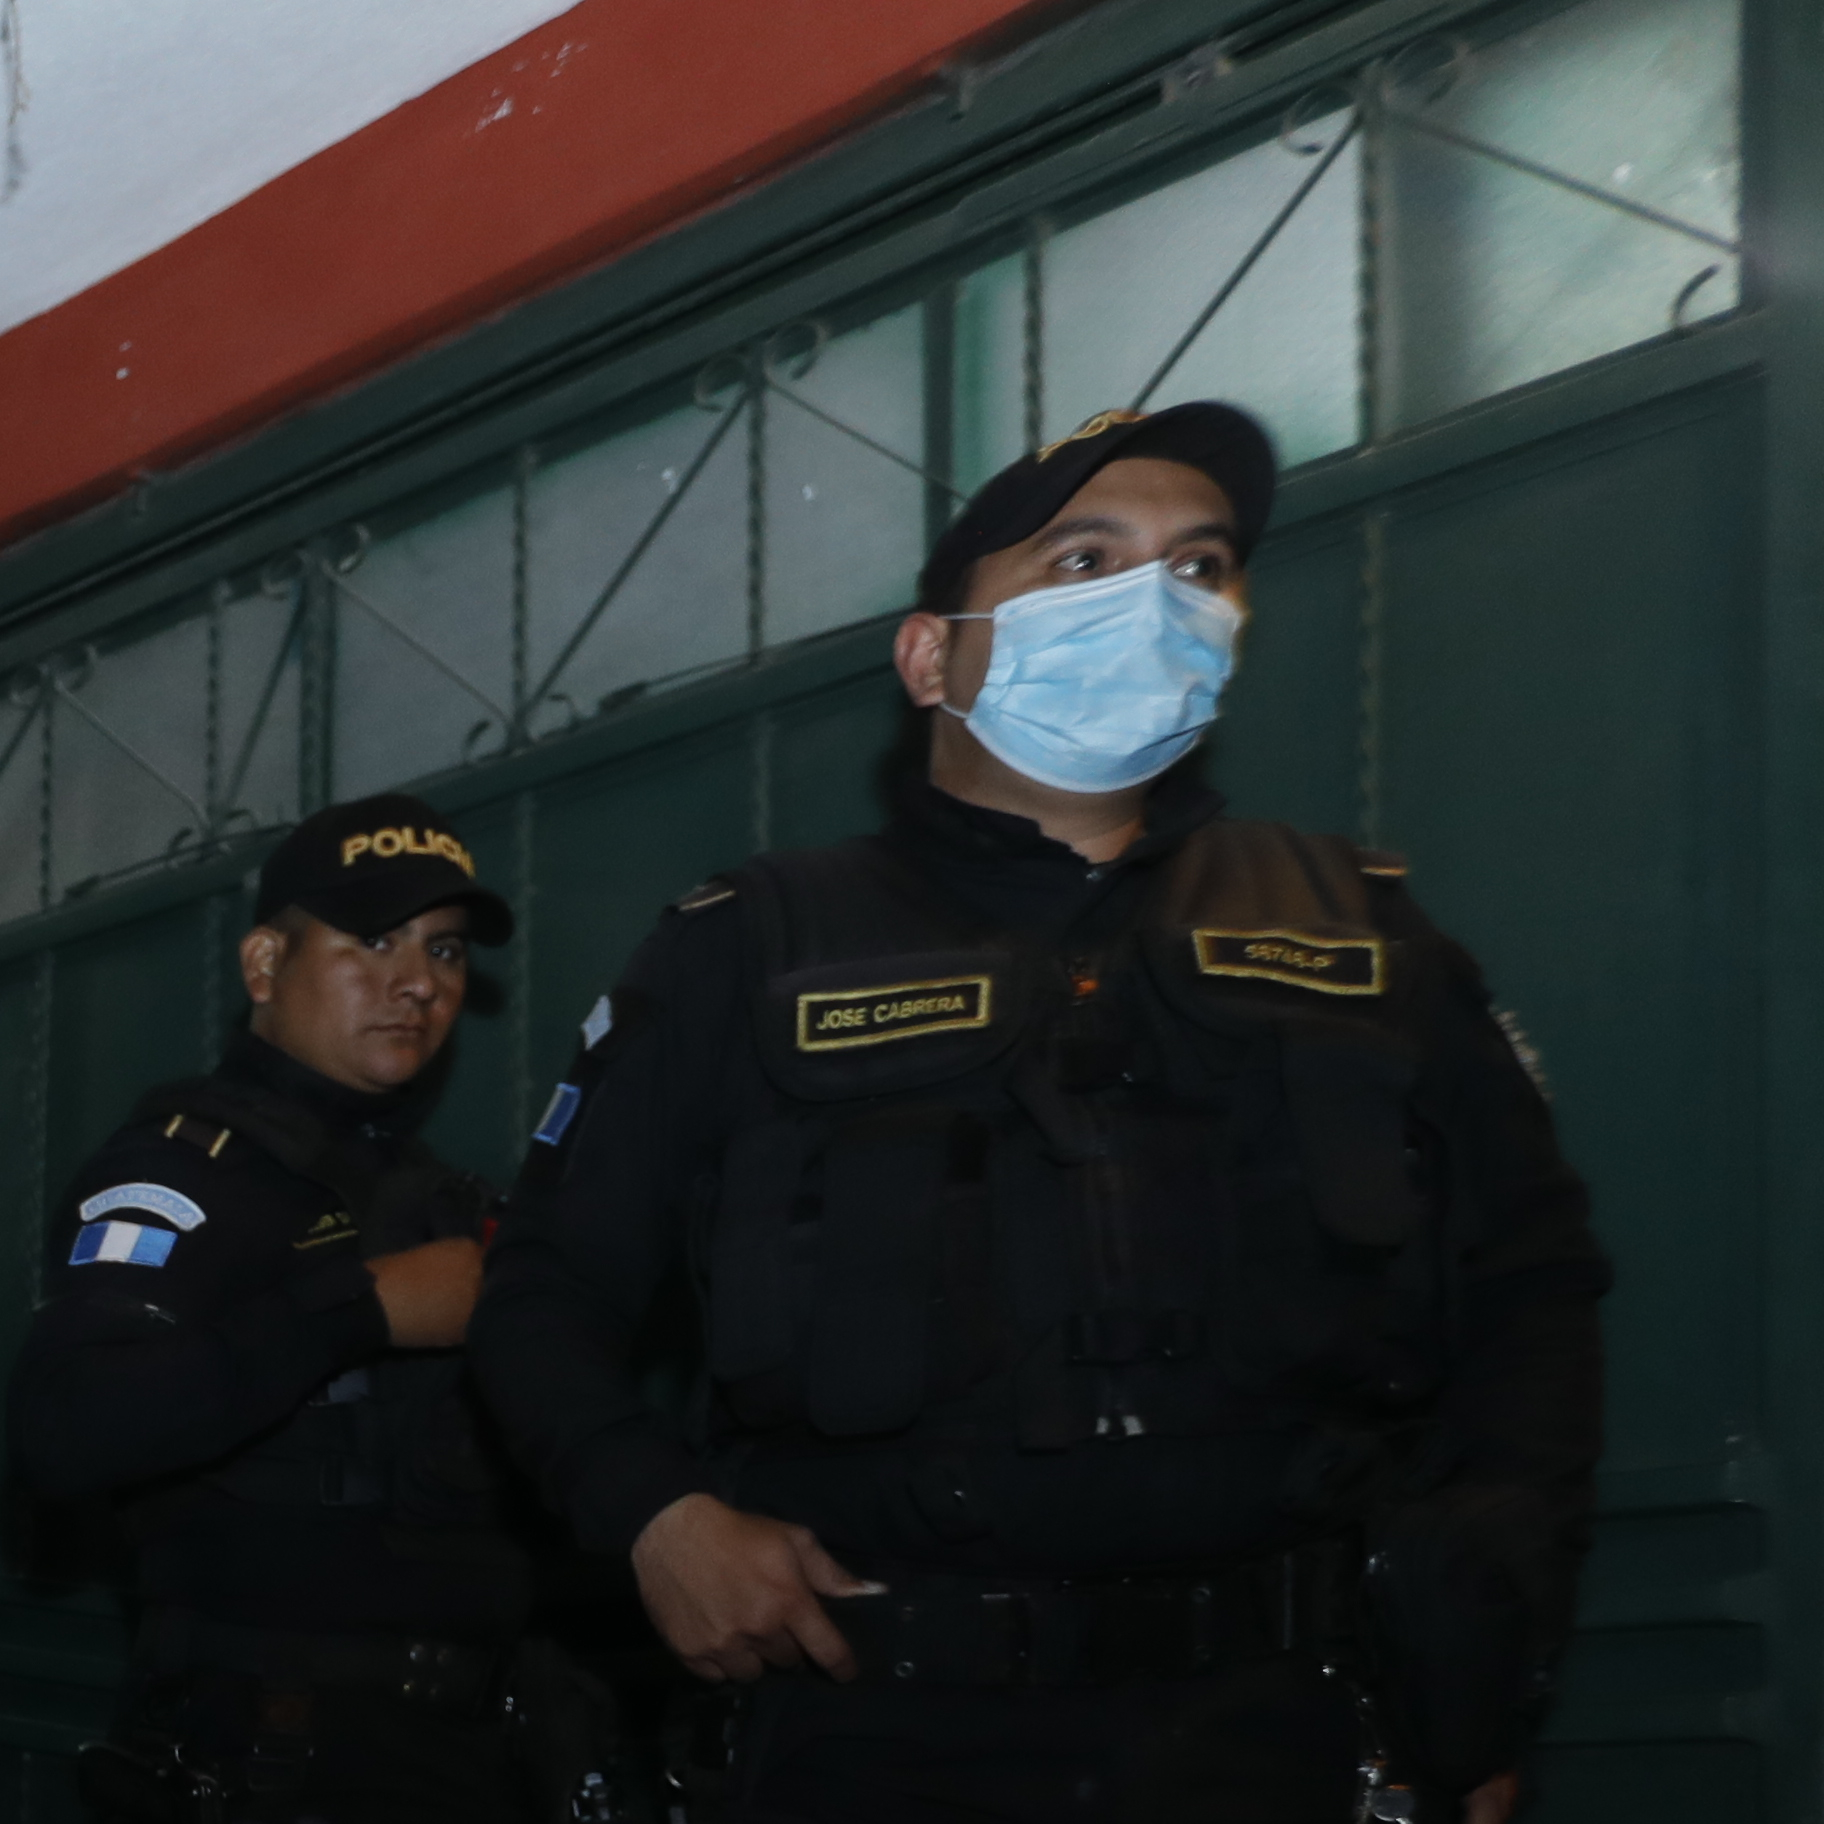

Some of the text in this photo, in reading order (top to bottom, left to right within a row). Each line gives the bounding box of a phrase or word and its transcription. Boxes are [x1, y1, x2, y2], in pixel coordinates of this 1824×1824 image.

[339, 825, 477, 880] POLIC
[815, 993, 967, 1031] JOSE CABRERA
